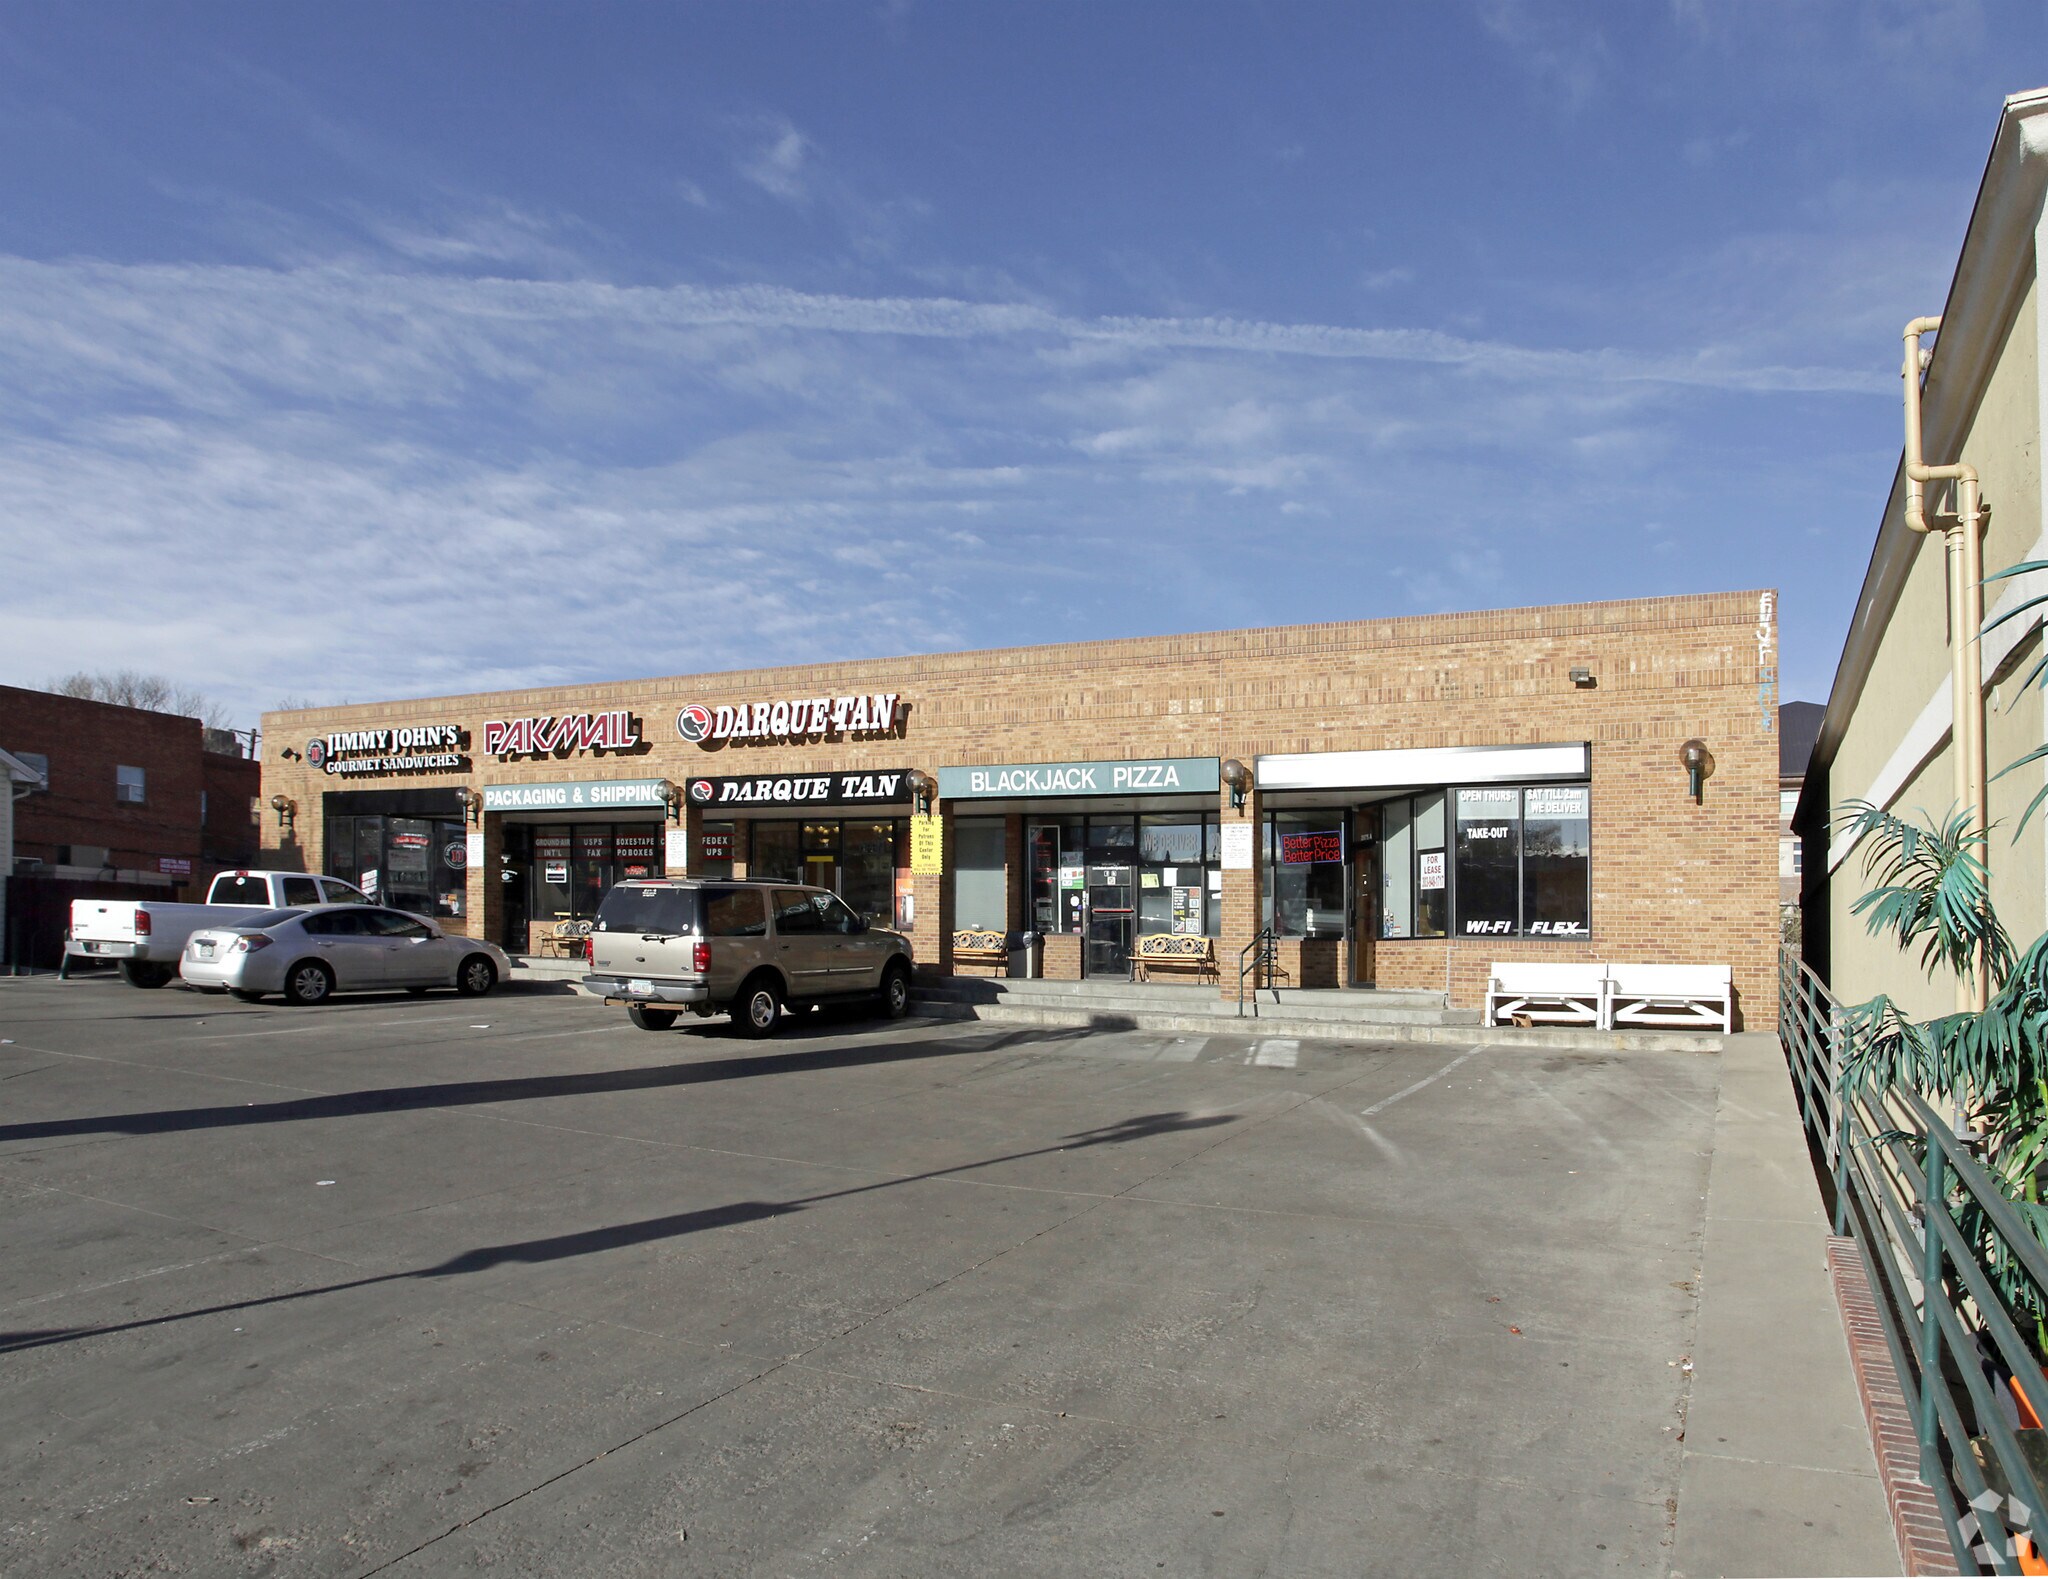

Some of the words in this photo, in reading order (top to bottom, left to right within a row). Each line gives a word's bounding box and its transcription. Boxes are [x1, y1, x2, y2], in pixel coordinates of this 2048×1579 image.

[712, 698, 831, 738] DARQUE
[834, 693, 897, 731] TAN
[327, 730, 388, 757] JIMMY
[391, 725, 458, 753] JOHN'S
[326, 759, 380, 773] GOURMET
[382, 754, 459, 770] SANDWICHES
[971, 768, 1097, 792] BLACKJACK
[1113, 765, 1180, 788] PIZZA
[719, 778, 831, 802] DARQUE
[842, 774, 901, 798] TAN
[486, 788, 566, 806] PACKAGING
[573, 786, 583, 803] &
[1460, 790, 1482, 801] OPEN
[1526, 789, 1544, 800] SAT
[1545, 789, 1563, 800] TILL
[1531, 802, 1545, 813] WE
[1546, 802, 1581, 813] DELIVER
[1467, 827, 1508, 839] TAKE-OUT
[583, 838, 602, 846] USPS
[702, 836, 728, 845] FEDEX
[1160, 833, 1198, 851] DELIVER
[1283, 836, 1312, 849] Better
[1313, 836, 1339, 849] Pizza
[587, 849, 601, 857] FAX
[617, 848, 627, 857] PO
[628, 848, 653, 857] BOXES
[706, 848, 722, 856] UPS
[1284, 850, 1314, 863] Better
[1314, 848, 1340, 861] Price
[1426, 855, 1439, 864] FOR
[1423, 865, 1442, 875] LEASE
[1466, 920, 1512, 934] WI-FI
[1530, 921, 1580, 935] FLEX
